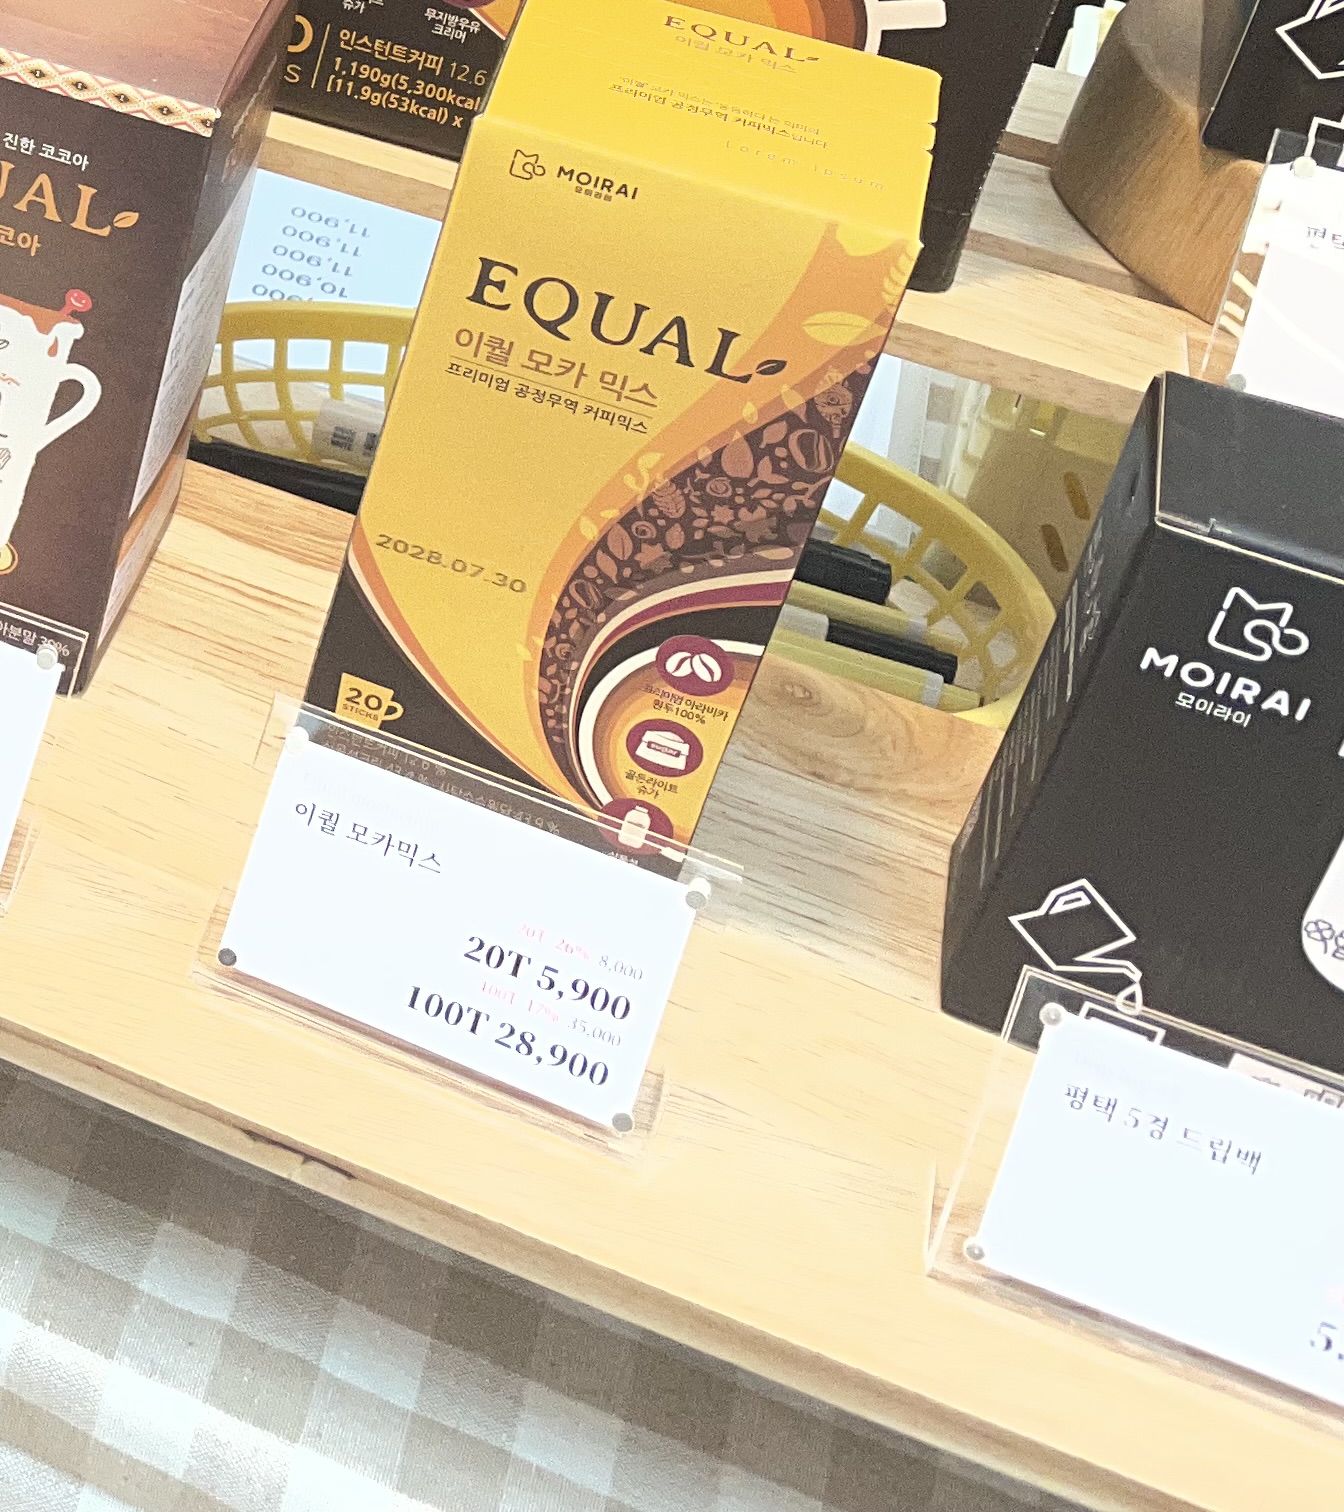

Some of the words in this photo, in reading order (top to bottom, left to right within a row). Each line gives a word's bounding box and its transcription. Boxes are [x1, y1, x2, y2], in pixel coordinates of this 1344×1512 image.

[431, 24, 467, 44] 크리머
[665, 15, 809, 63] EQUAL
[339, 28, 444, 75] 인스턴트커피
[447, 60, 488, 87] 12.6
[2, 130, 36, 158] 진한
[39, 140, 90, 172] 코코아
[557, 165, 639, 201] MOIRAI
[281, 224, 363, 258] 11,900
[290, 205, 372, 239] 11,900
[260, 262, 350, 300] 10,900
[271, 243, 355, 278] 11,900
[465, 256, 771, 385] EQUAL
[454, 326, 514, 368] 이퀄
[520, 341, 589, 389] 모카
[597, 362, 659, 409] 믹스
[445, 360, 511, 396] 프리미엄
[514, 379, 579, 416] 공정무역
[583, 402, 649, 436] 커피믹스
[375, 533, 527, 594] 2028.07.30
[345, 687, 384, 713] 20
[1140, 645, 1313, 724] MOIRAI
[342, 701, 380, 724] STICKS
[684, 697, 730, 721] 아라비카
[1175, 691, 1253, 728] 모이라이
[294, 801, 339, 835] 이퀄
[345, 822, 442, 874] 모카믹스
[462, 933, 531, 980] 20T
[535, 962, 632, 1022] 5,900
[598, 950, 644, 983] 8,000
[403, 982, 489, 1038] 100T
[494, 1019, 611, 1089] 28,900
[1063, 1081, 1119, 1124] 평택
[1122, 1104, 1170, 1144] 5경
